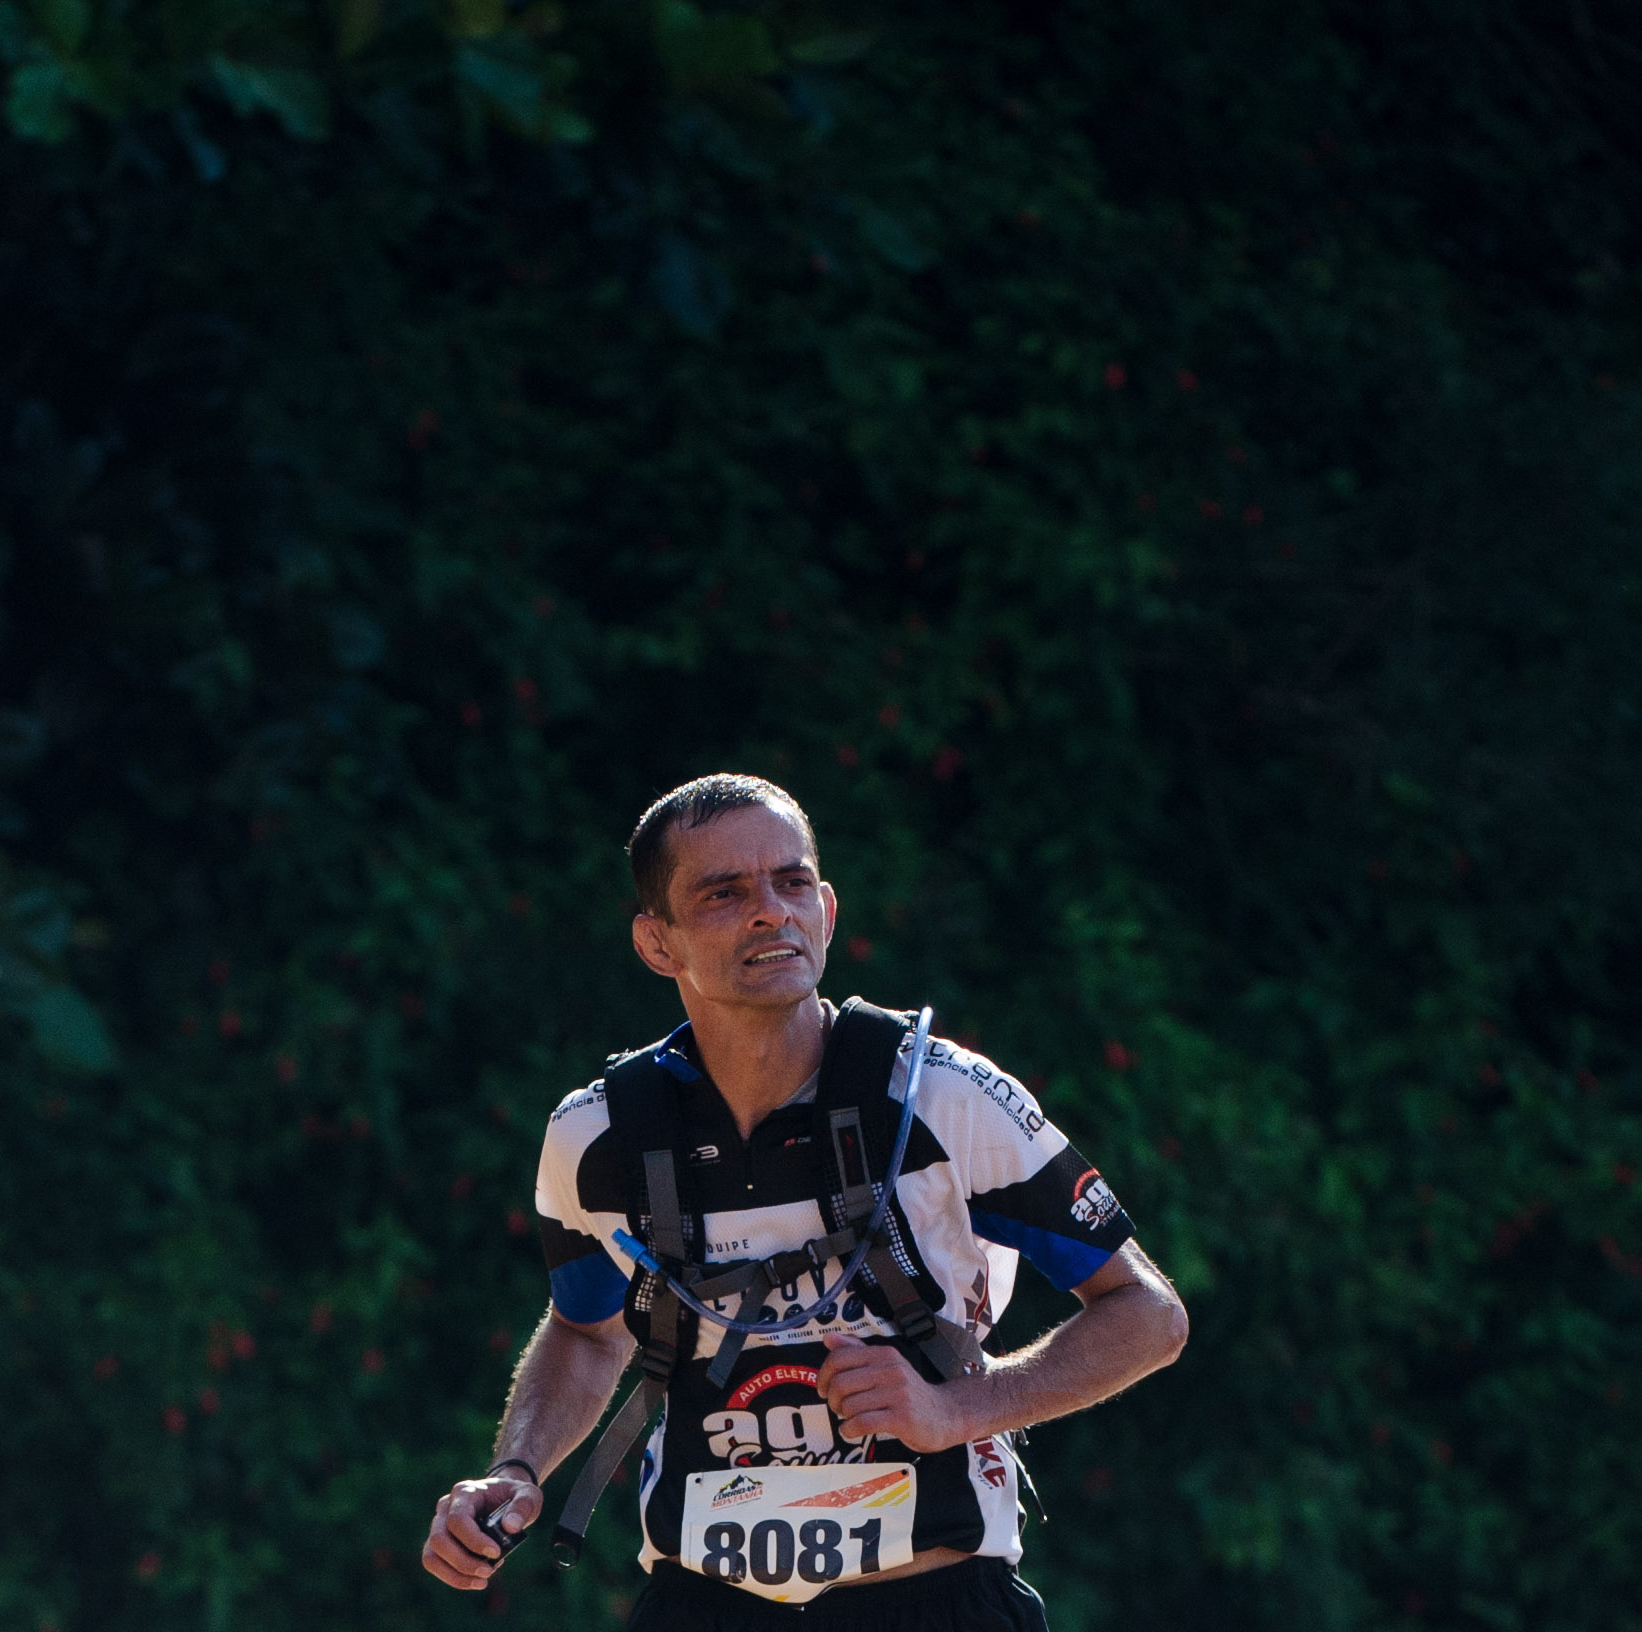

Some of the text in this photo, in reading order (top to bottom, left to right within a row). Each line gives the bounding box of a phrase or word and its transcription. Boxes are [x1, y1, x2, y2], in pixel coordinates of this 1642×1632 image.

[970, 1073, 984, 1087] de
[983, 1087, 1034, 1142] publicidade
[1070, 1178, 1110, 1222] ag
[706, 1239, 749, 1254] QUIPE
[739, 1368, 817, 1402] AUTO ELÉTR
[702, 1404, 898, 1461] ag
[701, 1517, 883, 1585] 8081
